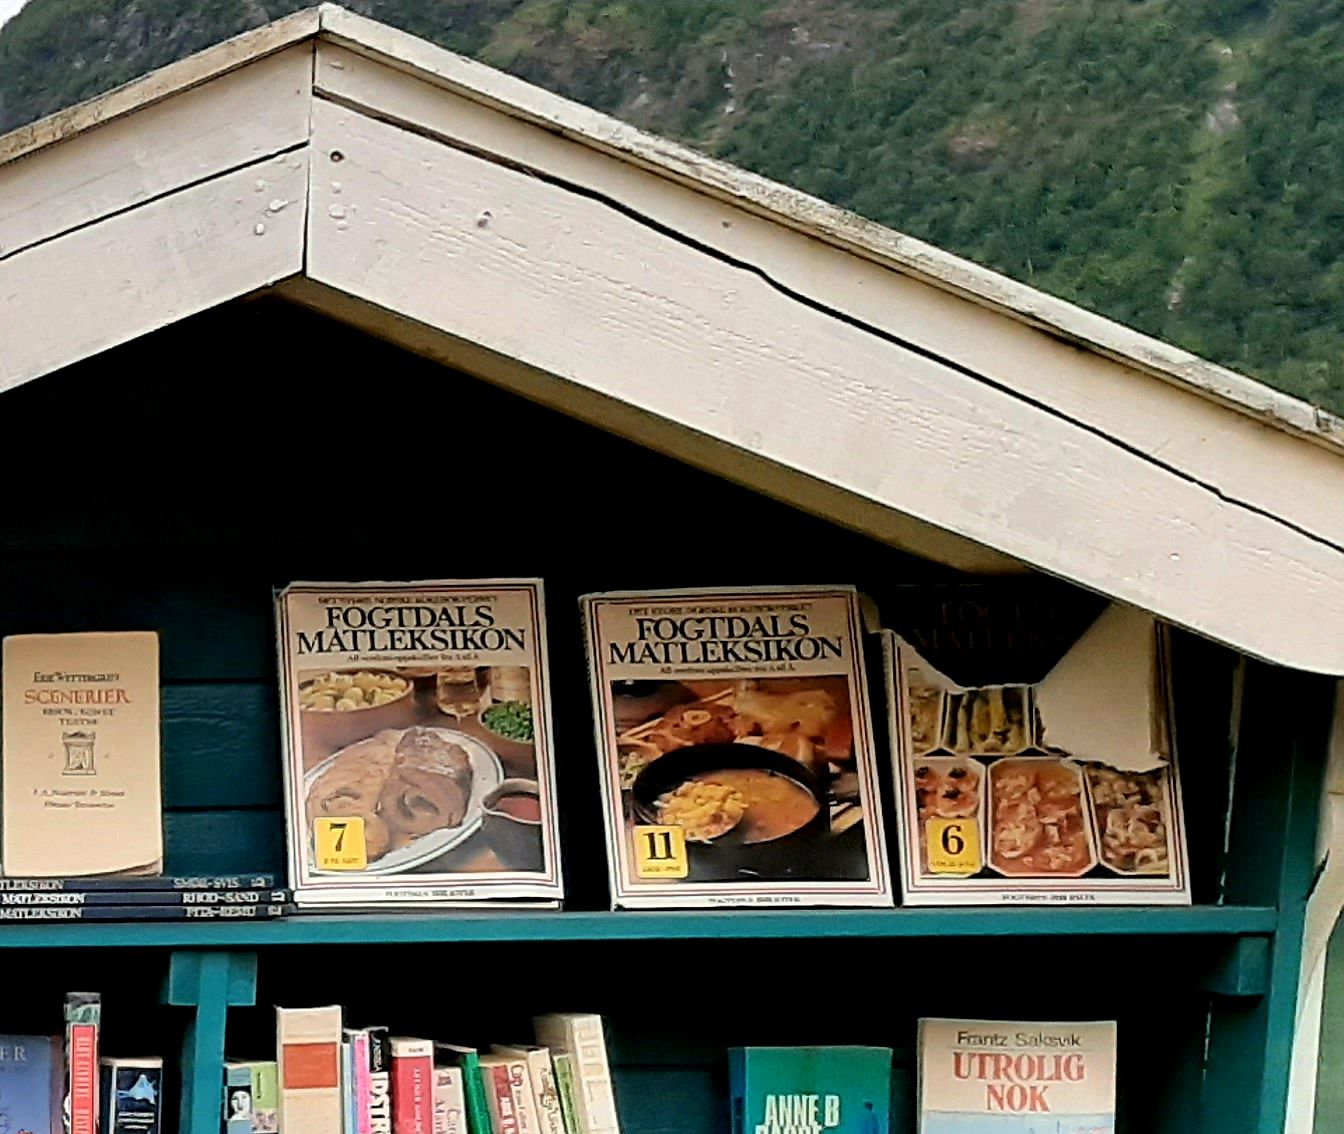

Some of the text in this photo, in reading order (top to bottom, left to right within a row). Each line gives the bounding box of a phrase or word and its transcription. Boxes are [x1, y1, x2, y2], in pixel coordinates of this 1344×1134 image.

[327, 605, 495, 629] FOGTDALS
[635, 614, 810, 641] FOGTDALS
[297, 628, 525, 655] MATLEKSIKON
[609, 636, 843, 665] MATLEKSIKON
[329, 823, 347, 852] 7
[643, 831, 677, 860] 11
[941, 824, 965, 855] 6
[0, 906, 83, 918] MATLEKSIKON
[2, 893, 85, 905] MATLEKSIKON
[957, 1031, 1009, 1047] Frantz
[953, 1052, 1085, 1083] UTROLIG
[764, 1094, 840, 1127] ANNE B
[985, 1084, 1051, 1113] NOK
